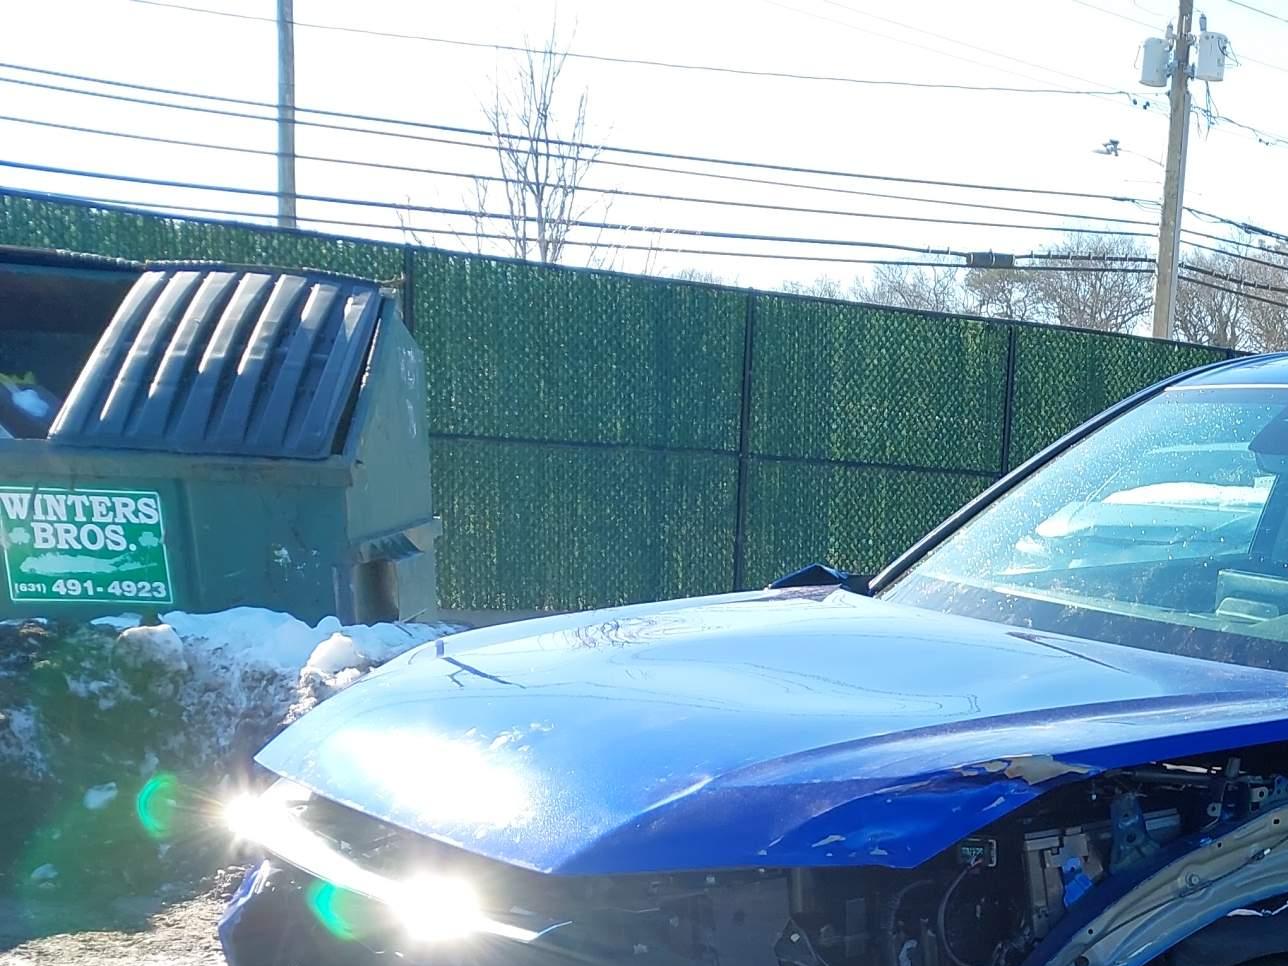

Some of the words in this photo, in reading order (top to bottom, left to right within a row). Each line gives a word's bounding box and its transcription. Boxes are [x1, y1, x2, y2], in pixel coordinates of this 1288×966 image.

[0, 493, 160, 525] WINTERS
[30, 522, 137, 551] BROS.
[14, 583, 47, 594] (631)
